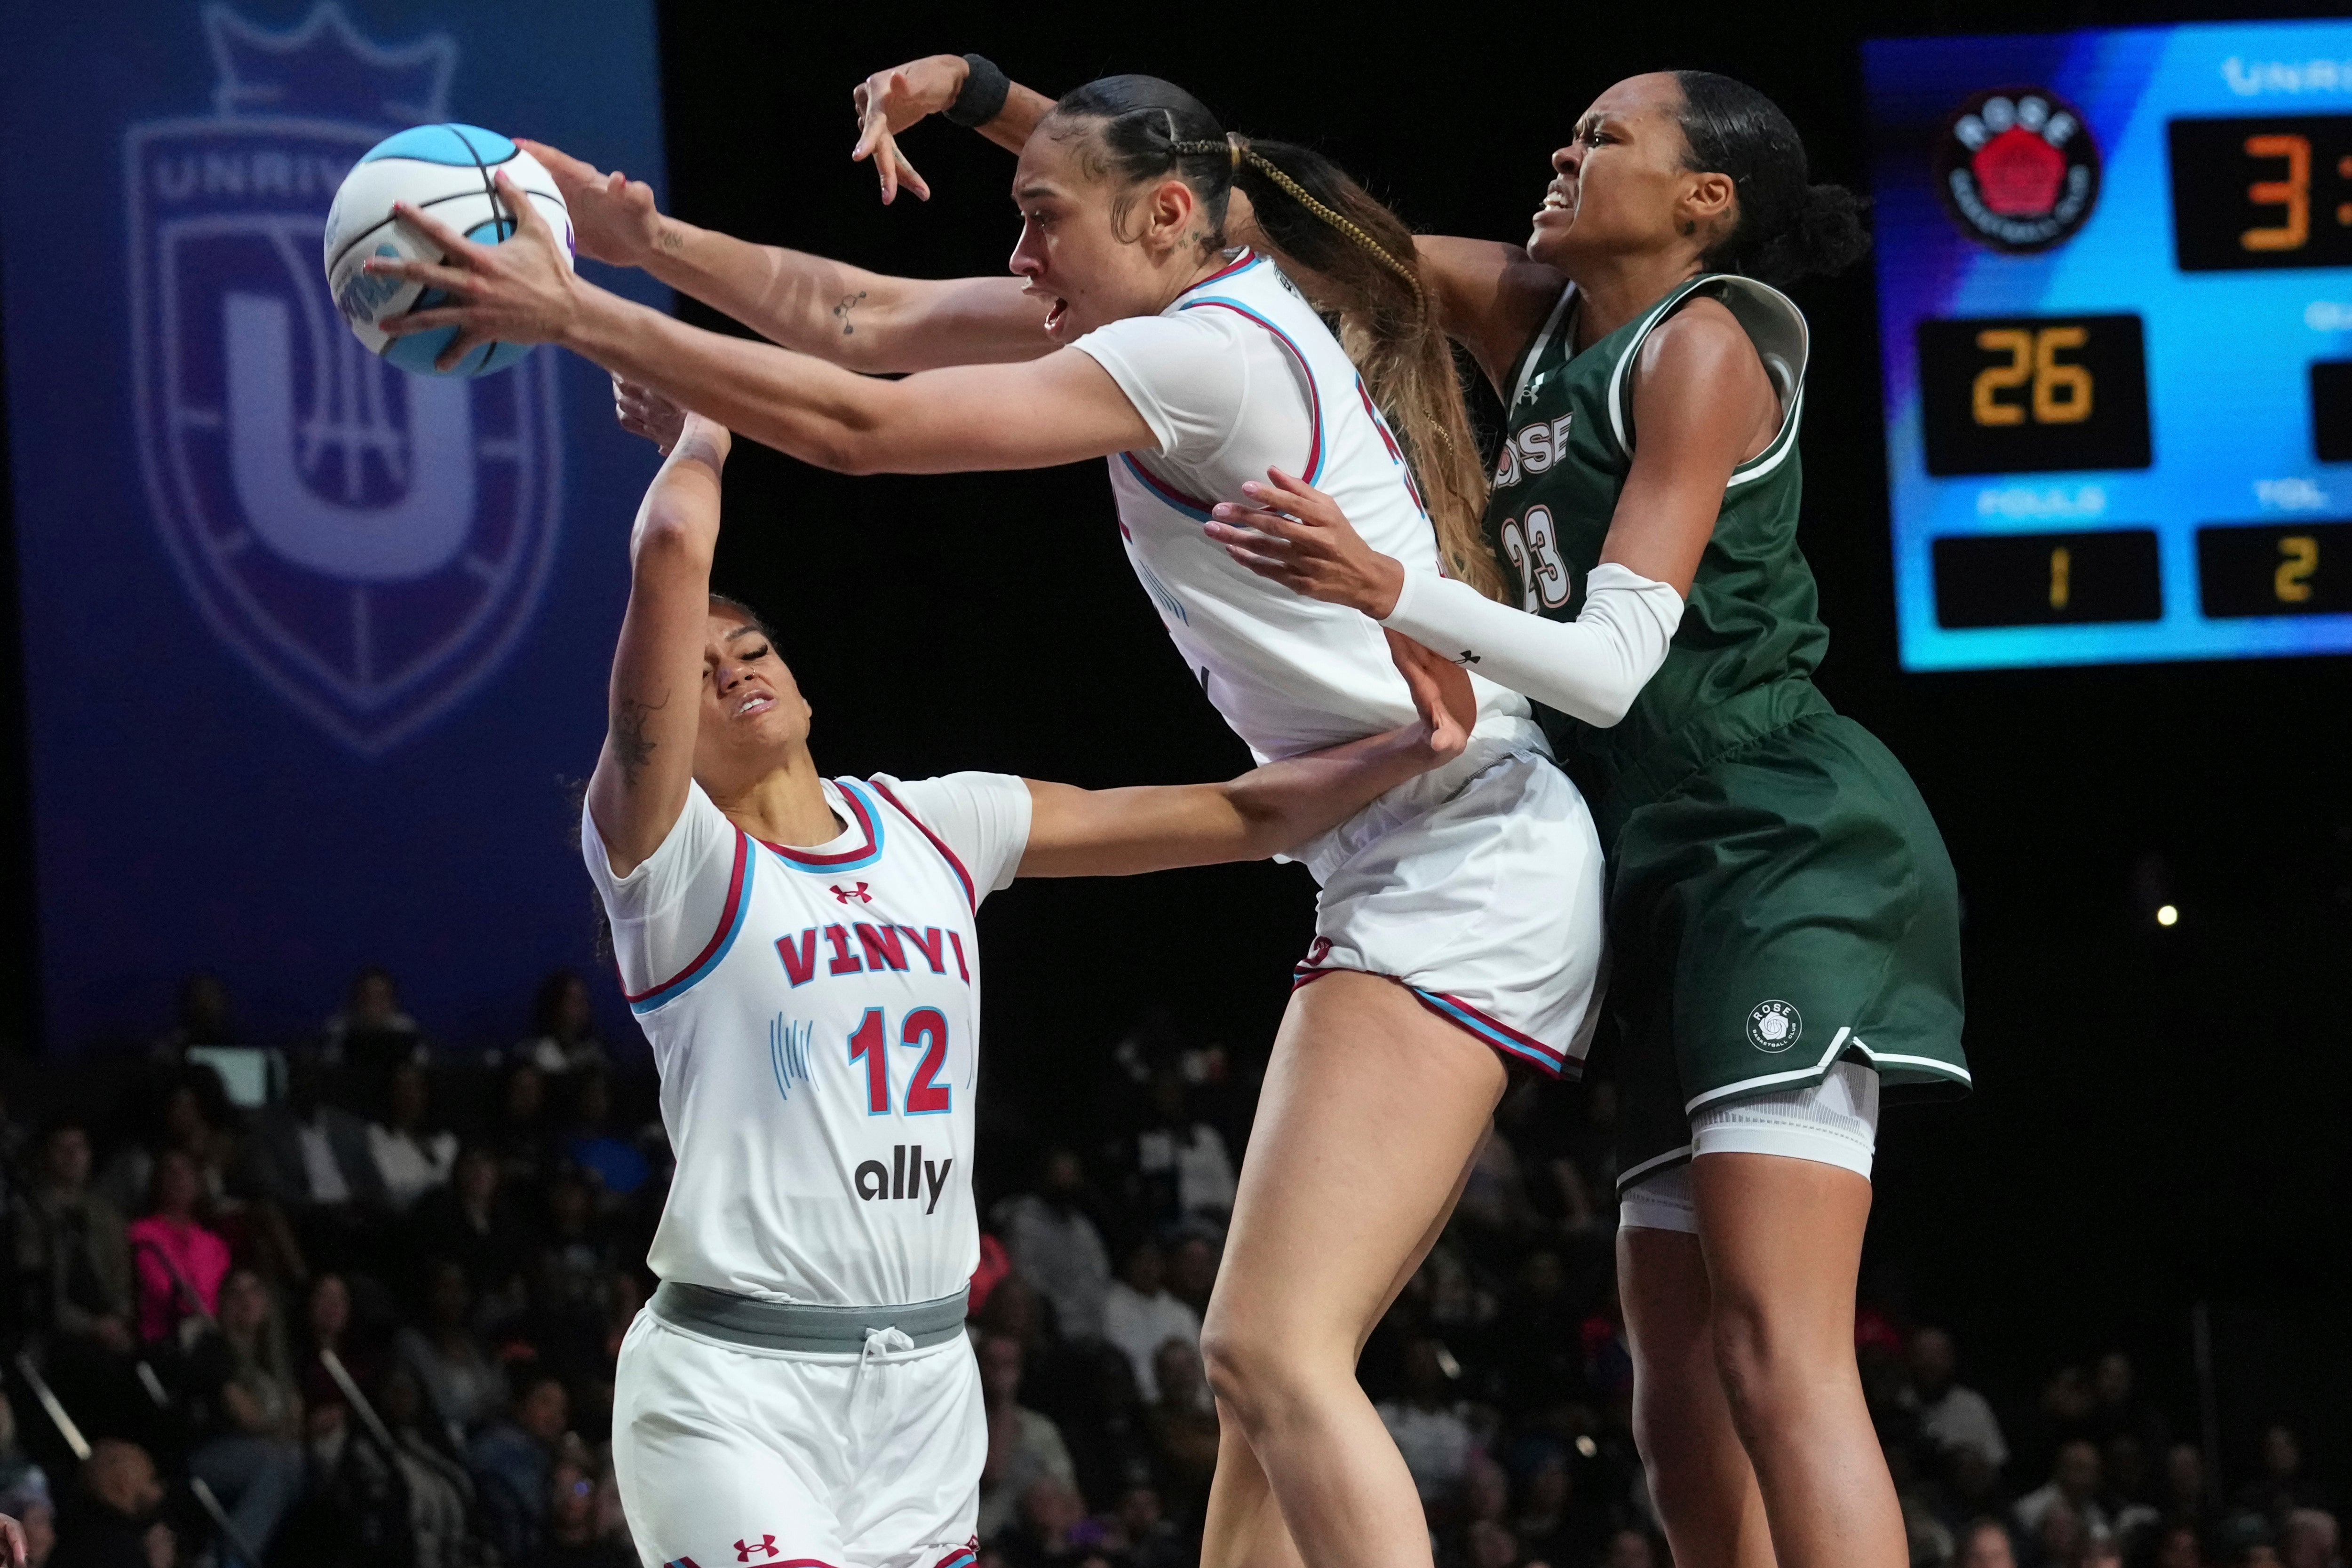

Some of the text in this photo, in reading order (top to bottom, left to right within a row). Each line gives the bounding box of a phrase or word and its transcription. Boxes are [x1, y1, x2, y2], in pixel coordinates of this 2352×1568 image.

[1973, 327, 2092, 425] 26
[1501, 505, 1570, 615] 23
[2050, 547, 2069, 608] 1
[2274, 537, 2318, 602] 2
[1752, 1029, 1788, 1047] BASKETBALL
[1753, 1003, 1791, 1021] ROSE
[849, 1006, 952, 1116] 12
[855, 1145, 953, 1215] ally
